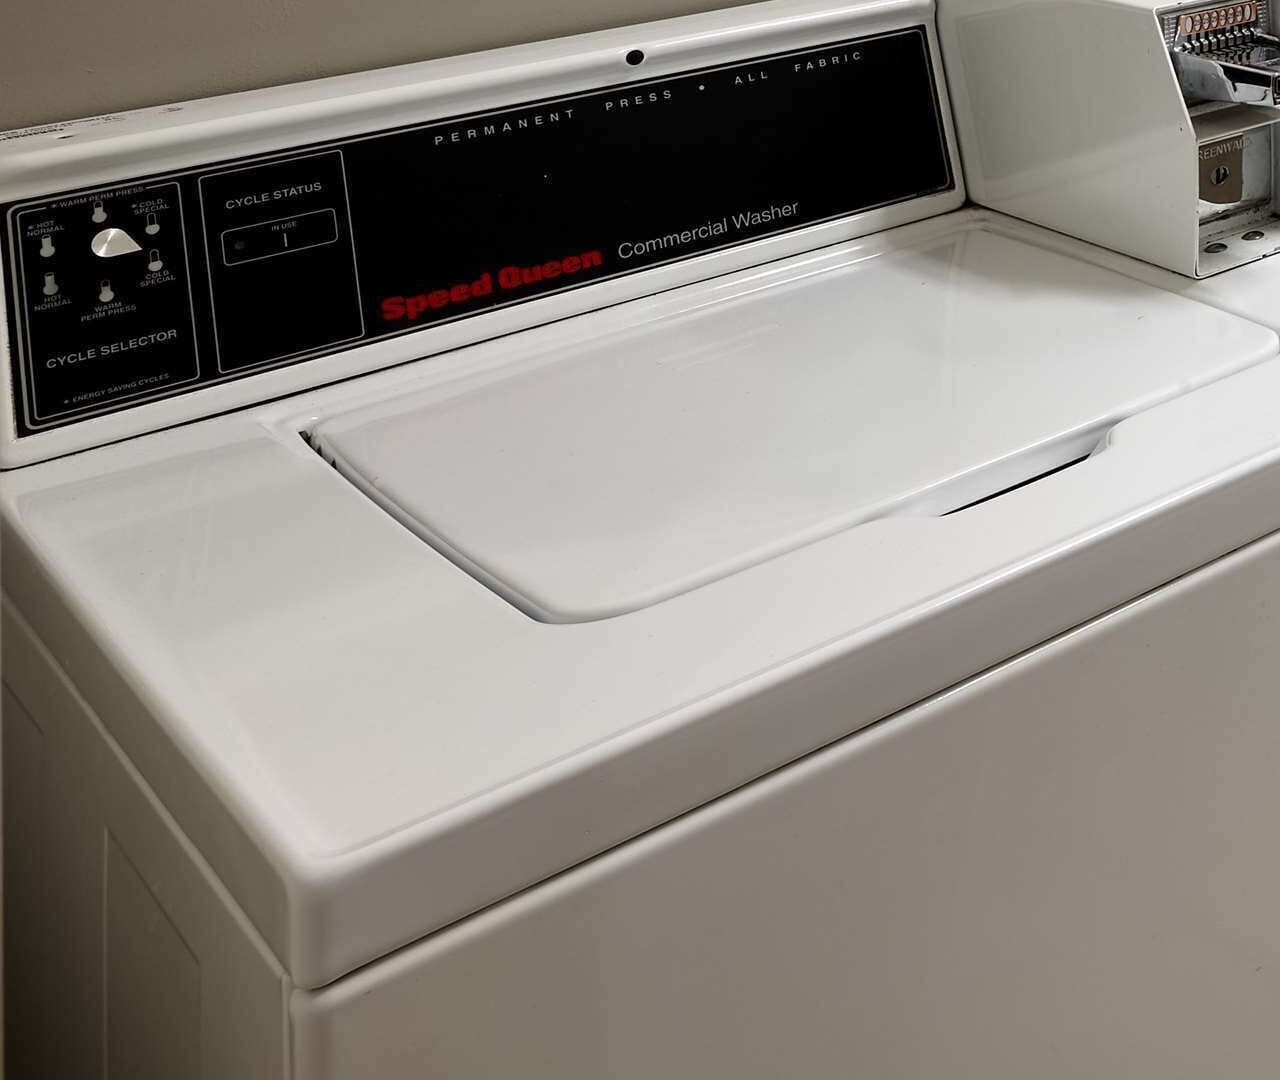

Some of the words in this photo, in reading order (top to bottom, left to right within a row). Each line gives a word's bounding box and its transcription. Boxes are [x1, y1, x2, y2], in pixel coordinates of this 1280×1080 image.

[434, 108, 575, 145] PERMANENT
[605, 90, 672, 111] PRESS
[734, 71, 769, 86] ALL
[795, 51, 863, 72] FABRIC
[60, 198, 87, 208] WARM
[90, 192, 114, 202] PERM
[116, 186, 144, 197] PRESS
[225, 193, 271, 209] CYCLE
[273, 182, 322, 199] STATUS
[134, 203, 170, 215] SPECIAL
[138, 198, 164, 209] COLD
[27, 225, 65, 237] NORMAL
[36, 221, 55, 229] HOT
[281, 221, 297, 229] USE
[380, 268, 493, 320] Speed
[499, 250, 603, 288] Queen
[617, 218, 728, 260] Commercial
[732, 202, 799, 230] Washer
[140, 275, 176, 288] SPECIAL
[145, 270, 170, 280] COLD
[34, 299, 72, 312] NORMAL
[44, 295, 62, 303] HOT
[81, 311, 106, 322] PERM
[108, 304, 137, 318] PRESS
[94, 301, 122, 313] WARM
[46, 348, 97, 369] CYCLE
[100, 329, 177, 356] SELECTOR
[72, 390, 105, 403] ENERGY
[108, 382, 137, 395] SAVING
[138, 373, 170, 386] CYCLES
